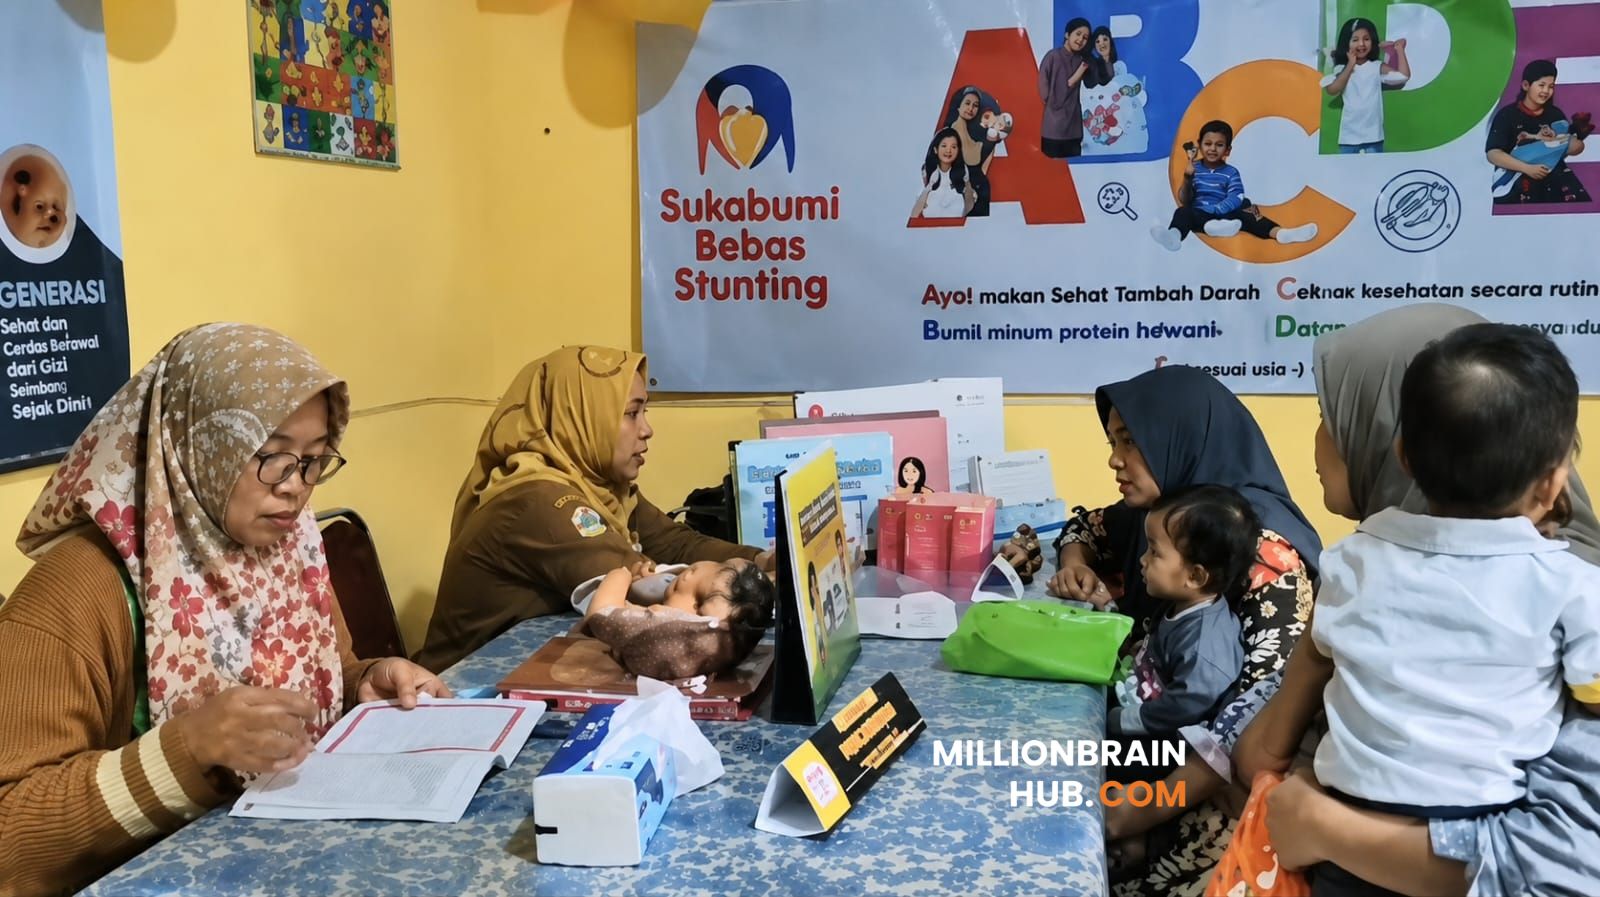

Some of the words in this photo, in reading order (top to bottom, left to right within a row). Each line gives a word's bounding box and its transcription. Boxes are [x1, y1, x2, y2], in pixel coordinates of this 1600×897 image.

[660, 186, 840, 222] Sukabumi
[695, 228, 806, 262] Bebas
[0, 280, 106, 308] GENERASI
[674, 267, 828, 310] Stunting
[921, 284, 972, 309] Ayo!
[979, 288, 1045, 304] makan
[1051, 287, 1108, 303] Sehat
[1115, 285, 1193, 302] Tambah
[1200, 284, 1260, 301] Darah
[1361, 282, 1464, 299] kesehatan
[1471, 283, 1543, 297] secara
[1550, 280, 1599, 297] rutin
[0, 317, 40, 334] Sehat
[42, 316, 68, 331] dan
[923, 320, 982, 340] Bumil
[988, 324, 1052, 340] minum
[1059, 323, 1129, 343] protein
[3, 340, 48, 356] Cerdas
[50, 334, 99, 352] Berawal
[7, 360, 37, 377] dari
[40, 356, 68, 374] Gizi
[1252, 361, 1286, 377] usia
[10, 381, 67, 398] Seimbang
[12, 400, 54, 420] Sejak
